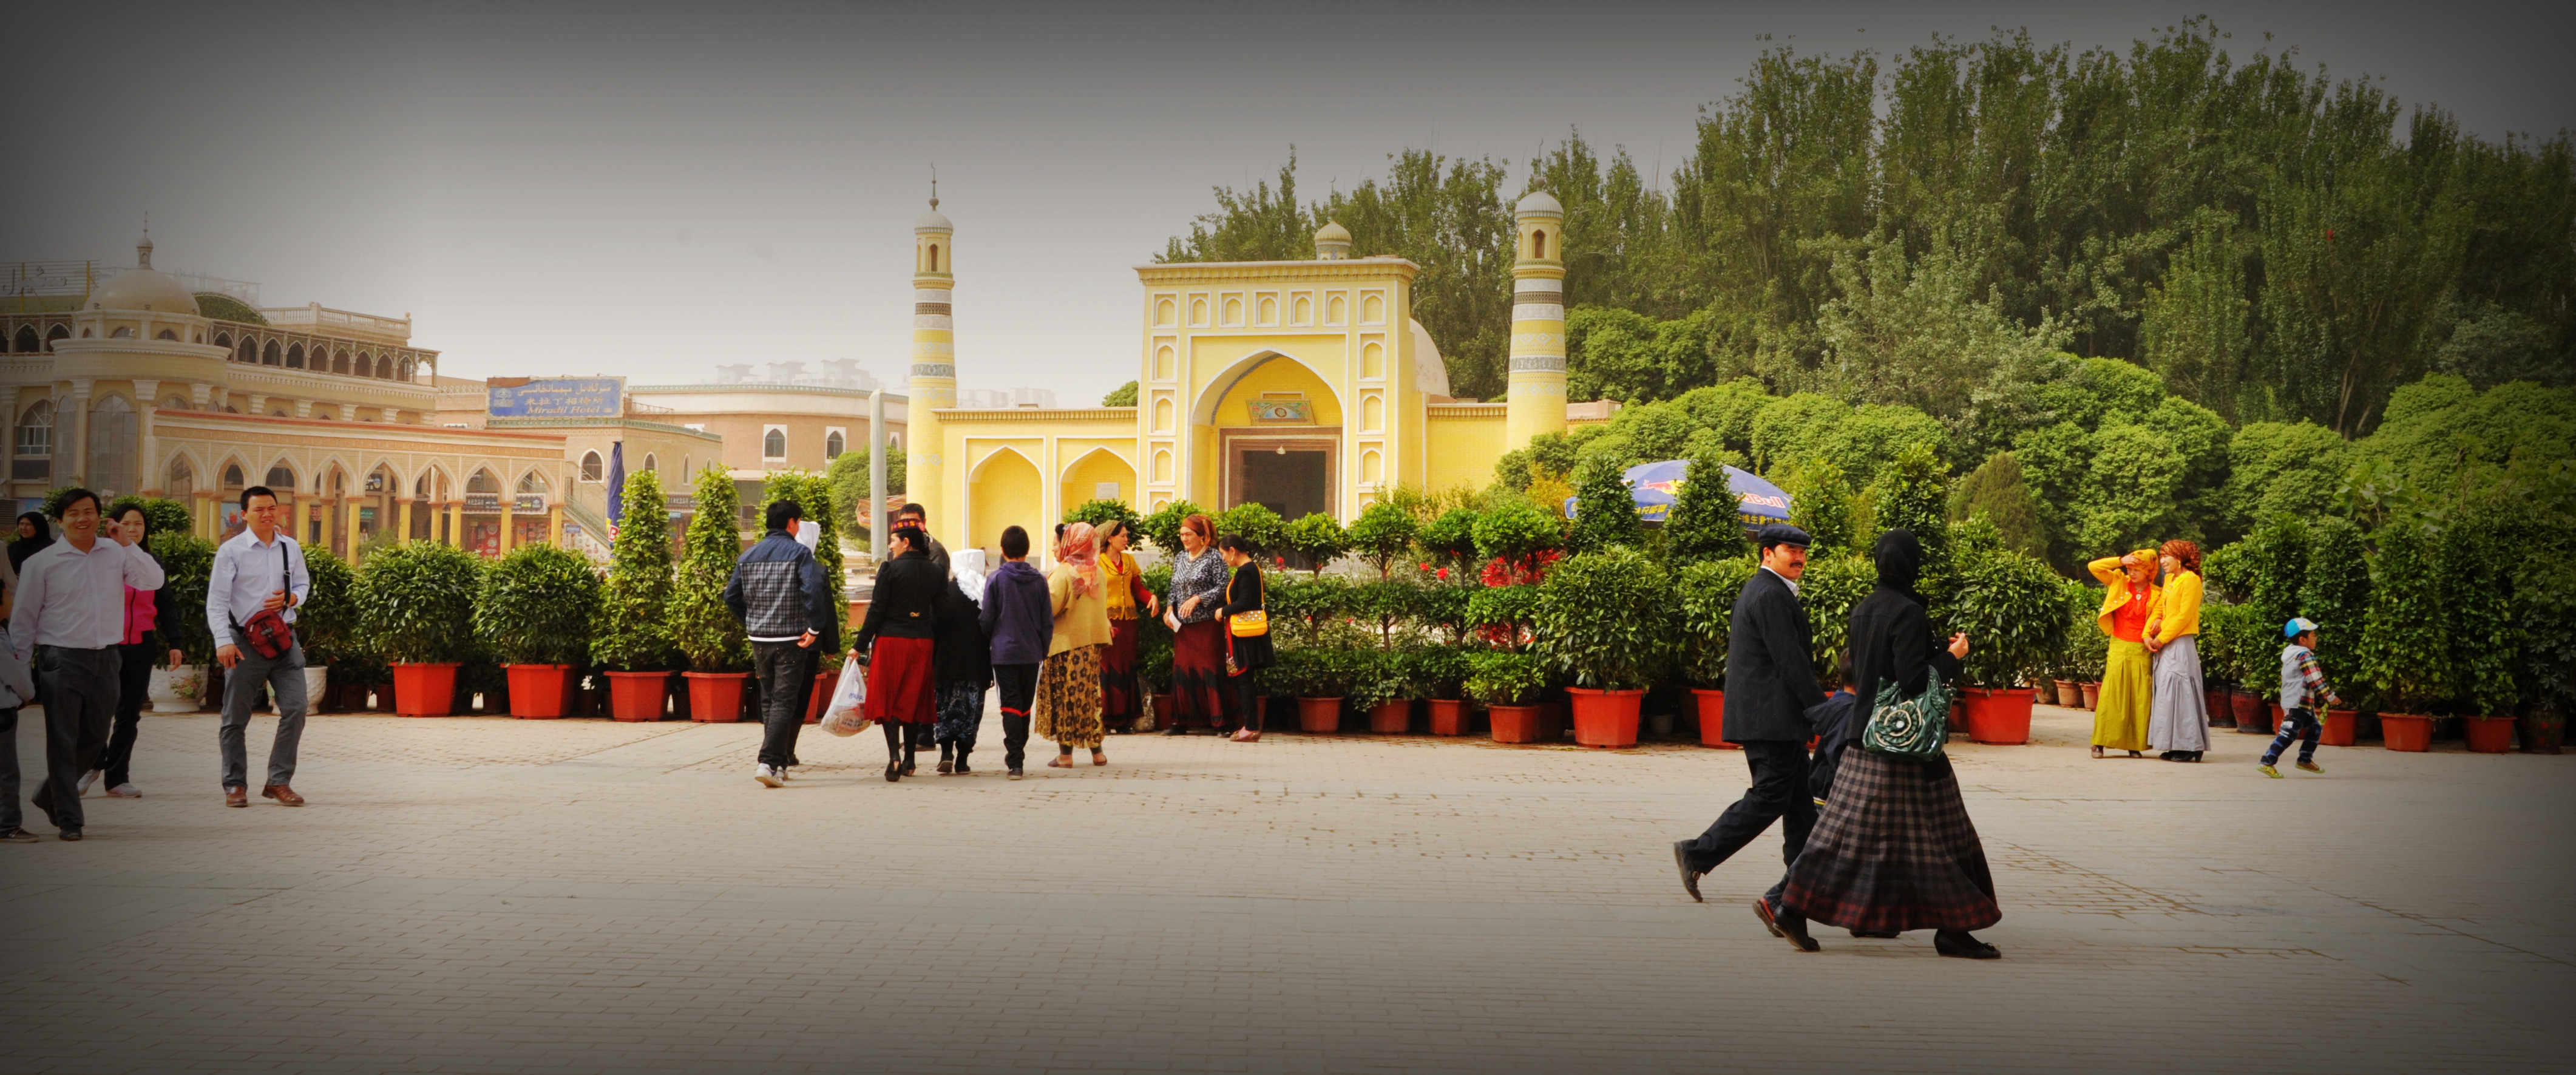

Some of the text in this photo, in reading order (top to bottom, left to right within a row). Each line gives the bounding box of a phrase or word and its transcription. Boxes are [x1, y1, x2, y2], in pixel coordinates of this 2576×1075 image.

[525, 396, 603, 406] 米拉丁招待所
